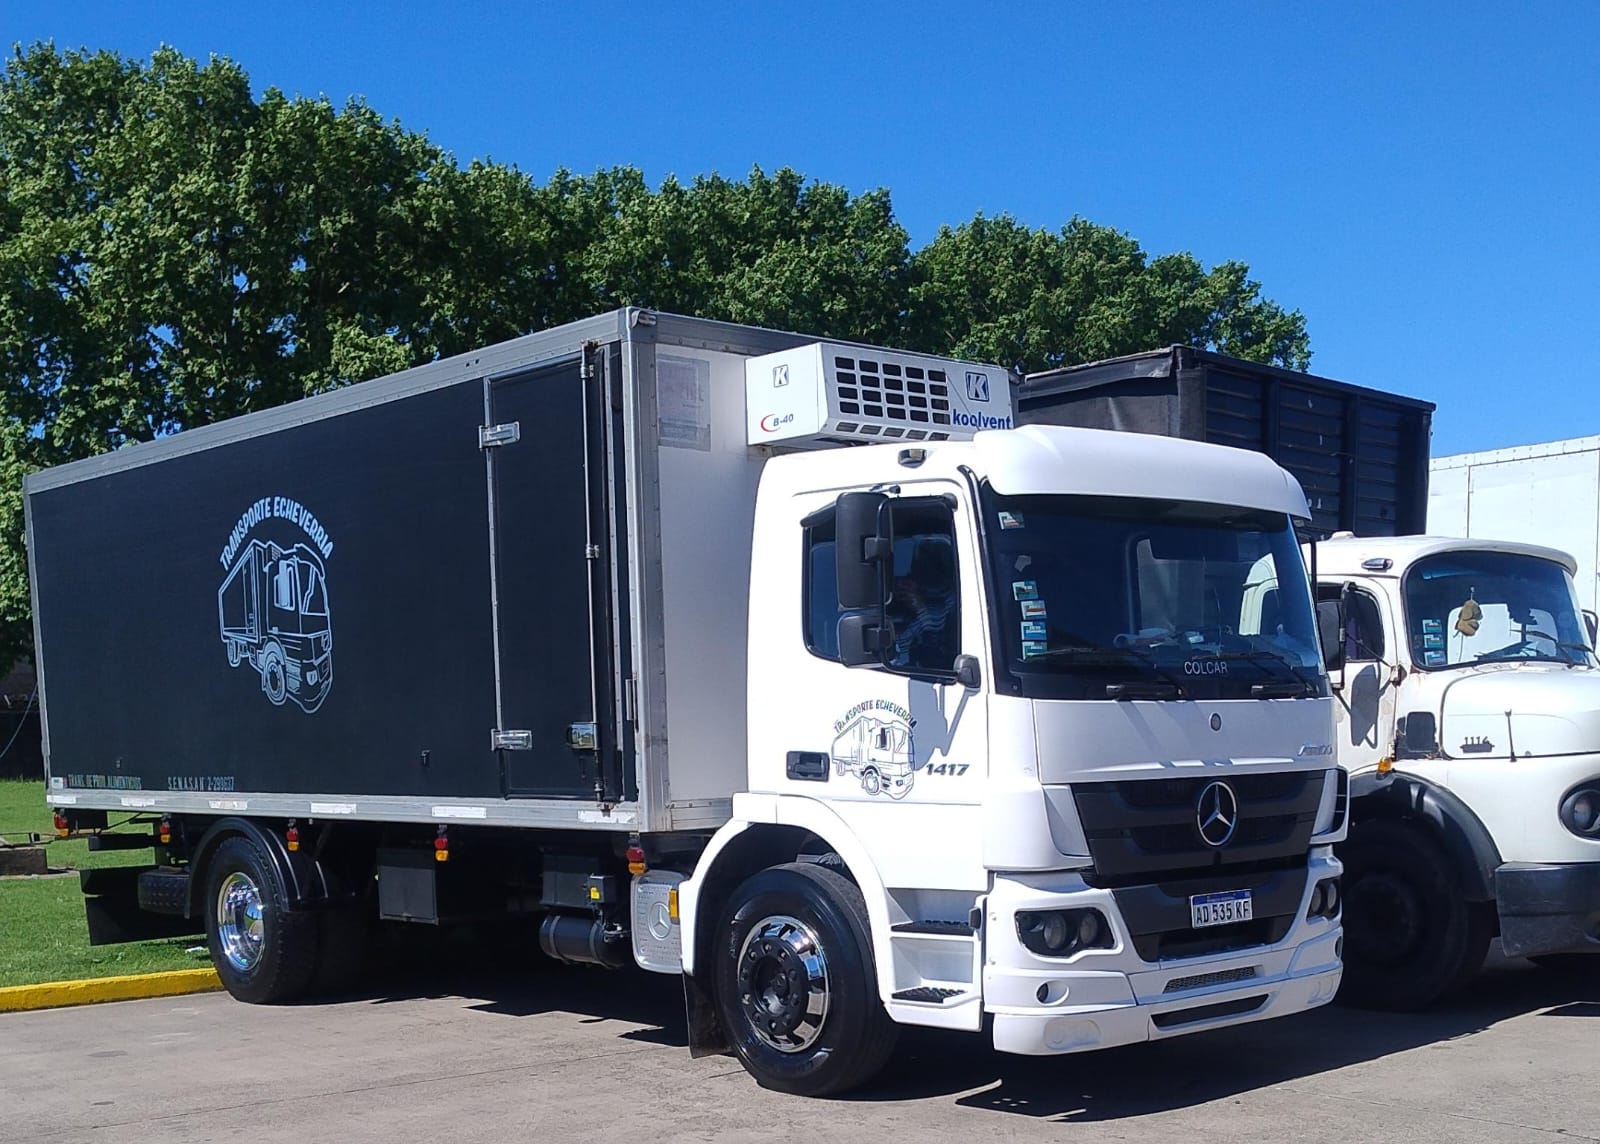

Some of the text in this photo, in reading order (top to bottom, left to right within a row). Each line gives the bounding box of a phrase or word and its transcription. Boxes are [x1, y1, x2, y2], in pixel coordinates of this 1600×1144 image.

[967, 374, 988, 401] K
[773, 413, 794, 427] B-40
[953, 408, 1011, 430] koolvent
[220, 496, 334, 571] TRANSPORTE ECHEVERRIA
[1184, 661, 1228, 675] COLCAR
[834, 699, 874, 734] TRANSPORTE
[926, 763, 970, 776] 1417
[1196, 900, 1249, 924] AD 535 KF
